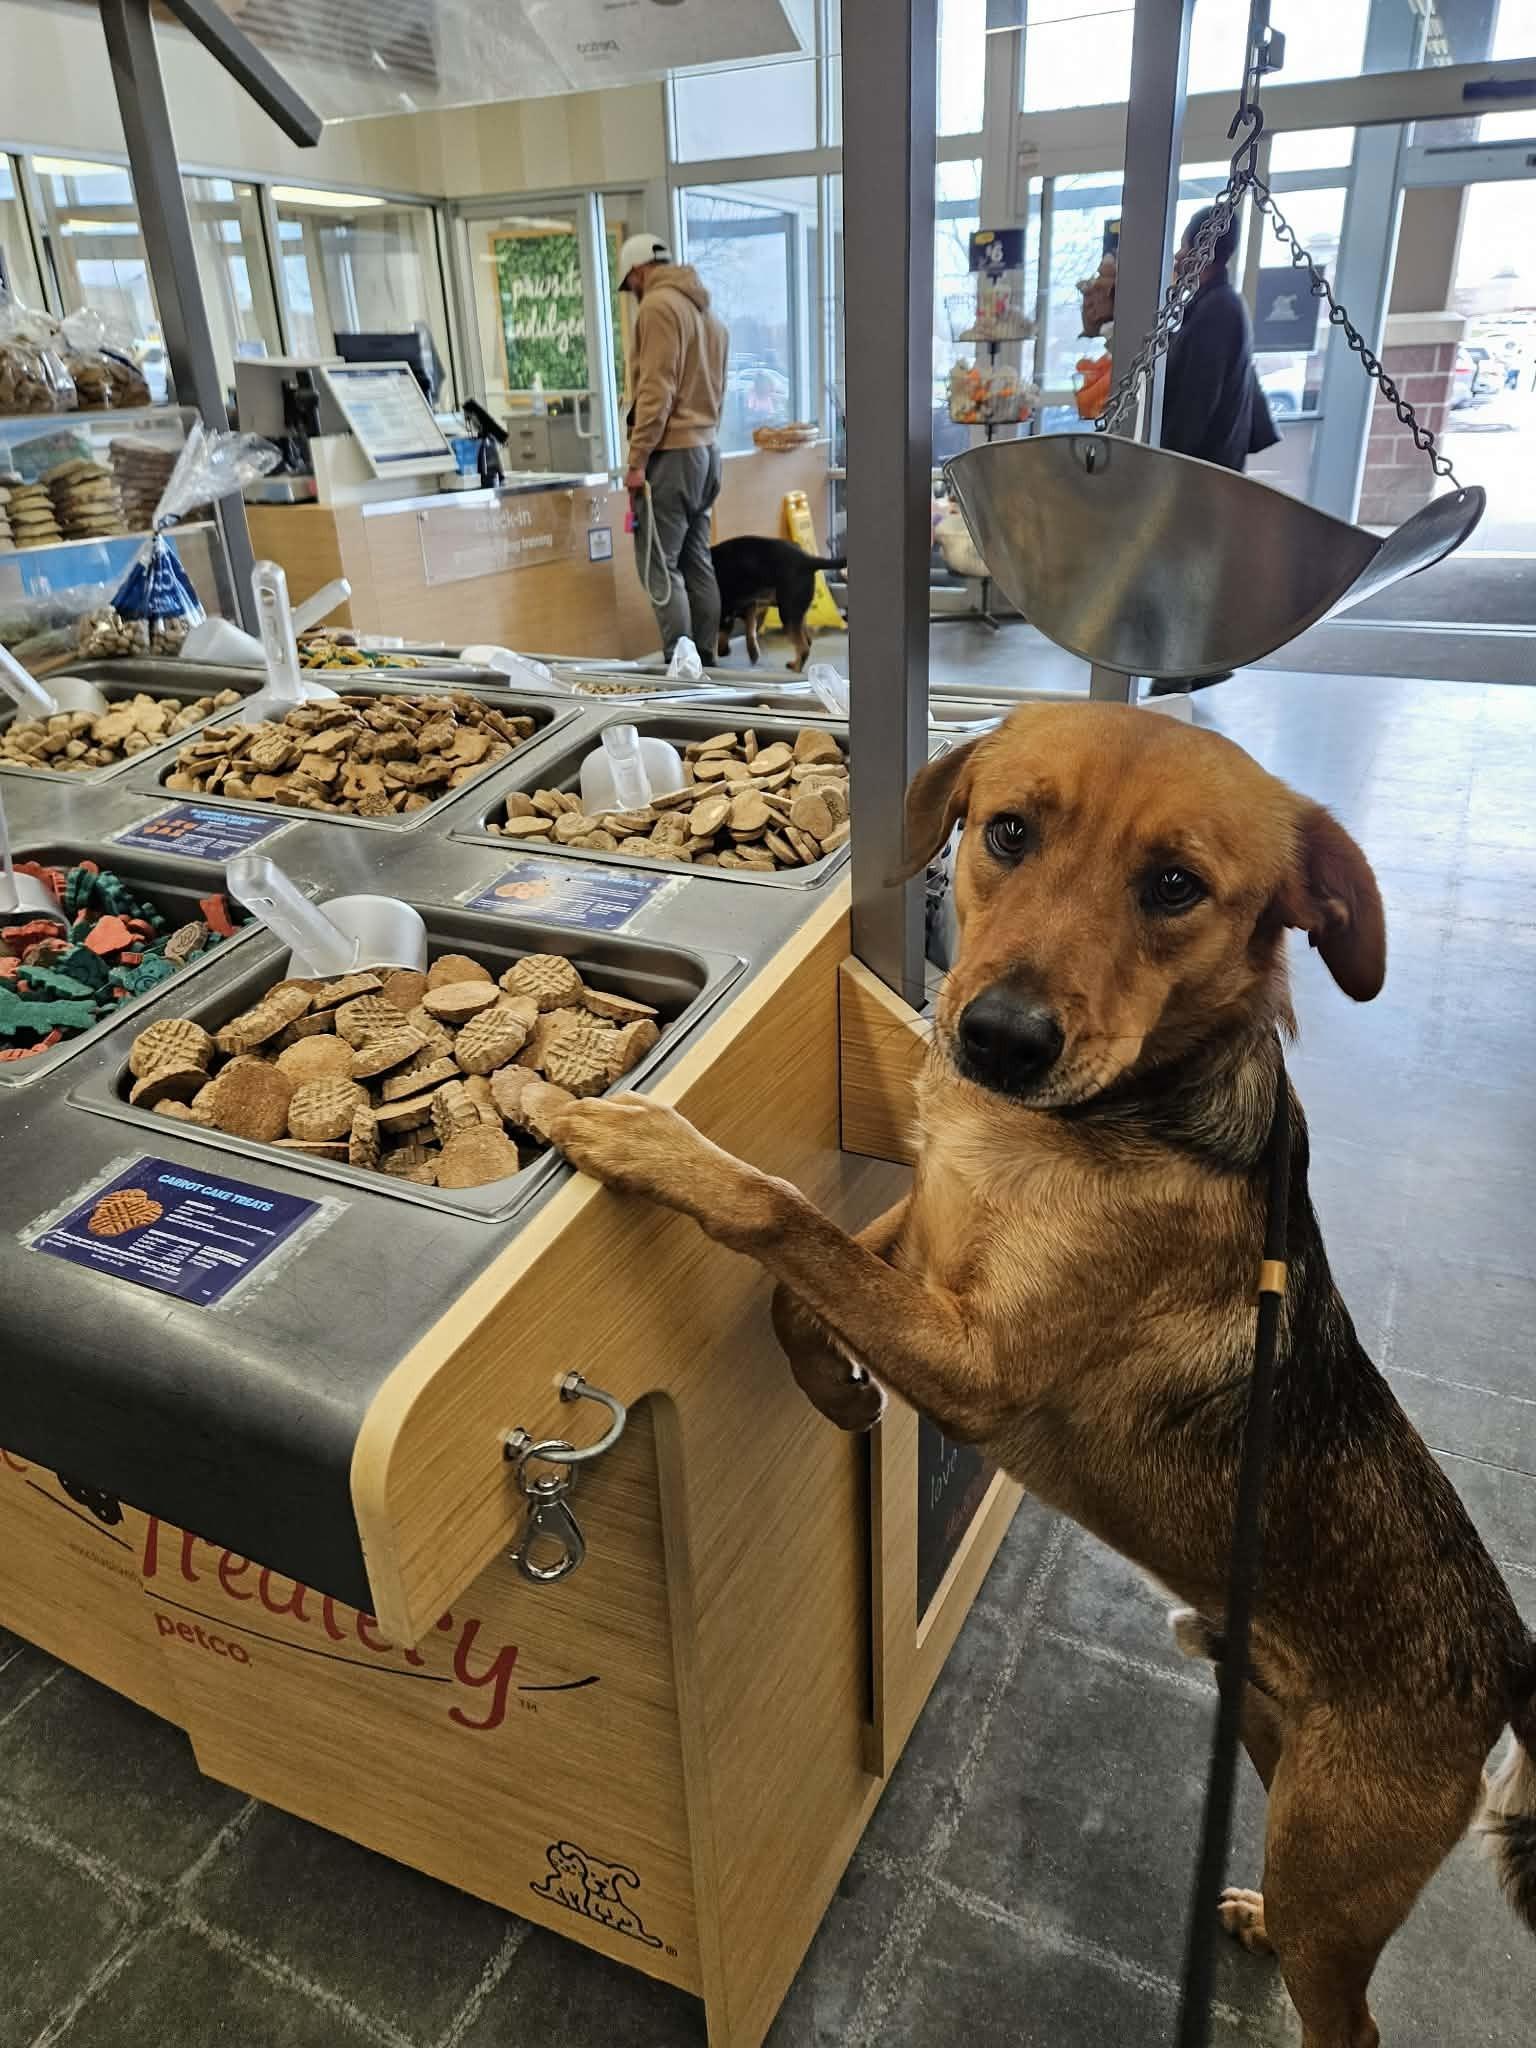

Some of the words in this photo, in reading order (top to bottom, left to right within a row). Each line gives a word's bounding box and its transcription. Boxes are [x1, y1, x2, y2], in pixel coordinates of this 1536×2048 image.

[158, 1174, 204, 1192] CARROT
[201, 1186, 234, 1203] CAKE
[230, 1192, 275, 1213] TREATS
[143, 1517, 518, 1730] Treaey
[154, 1612, 250, 1665] petco
